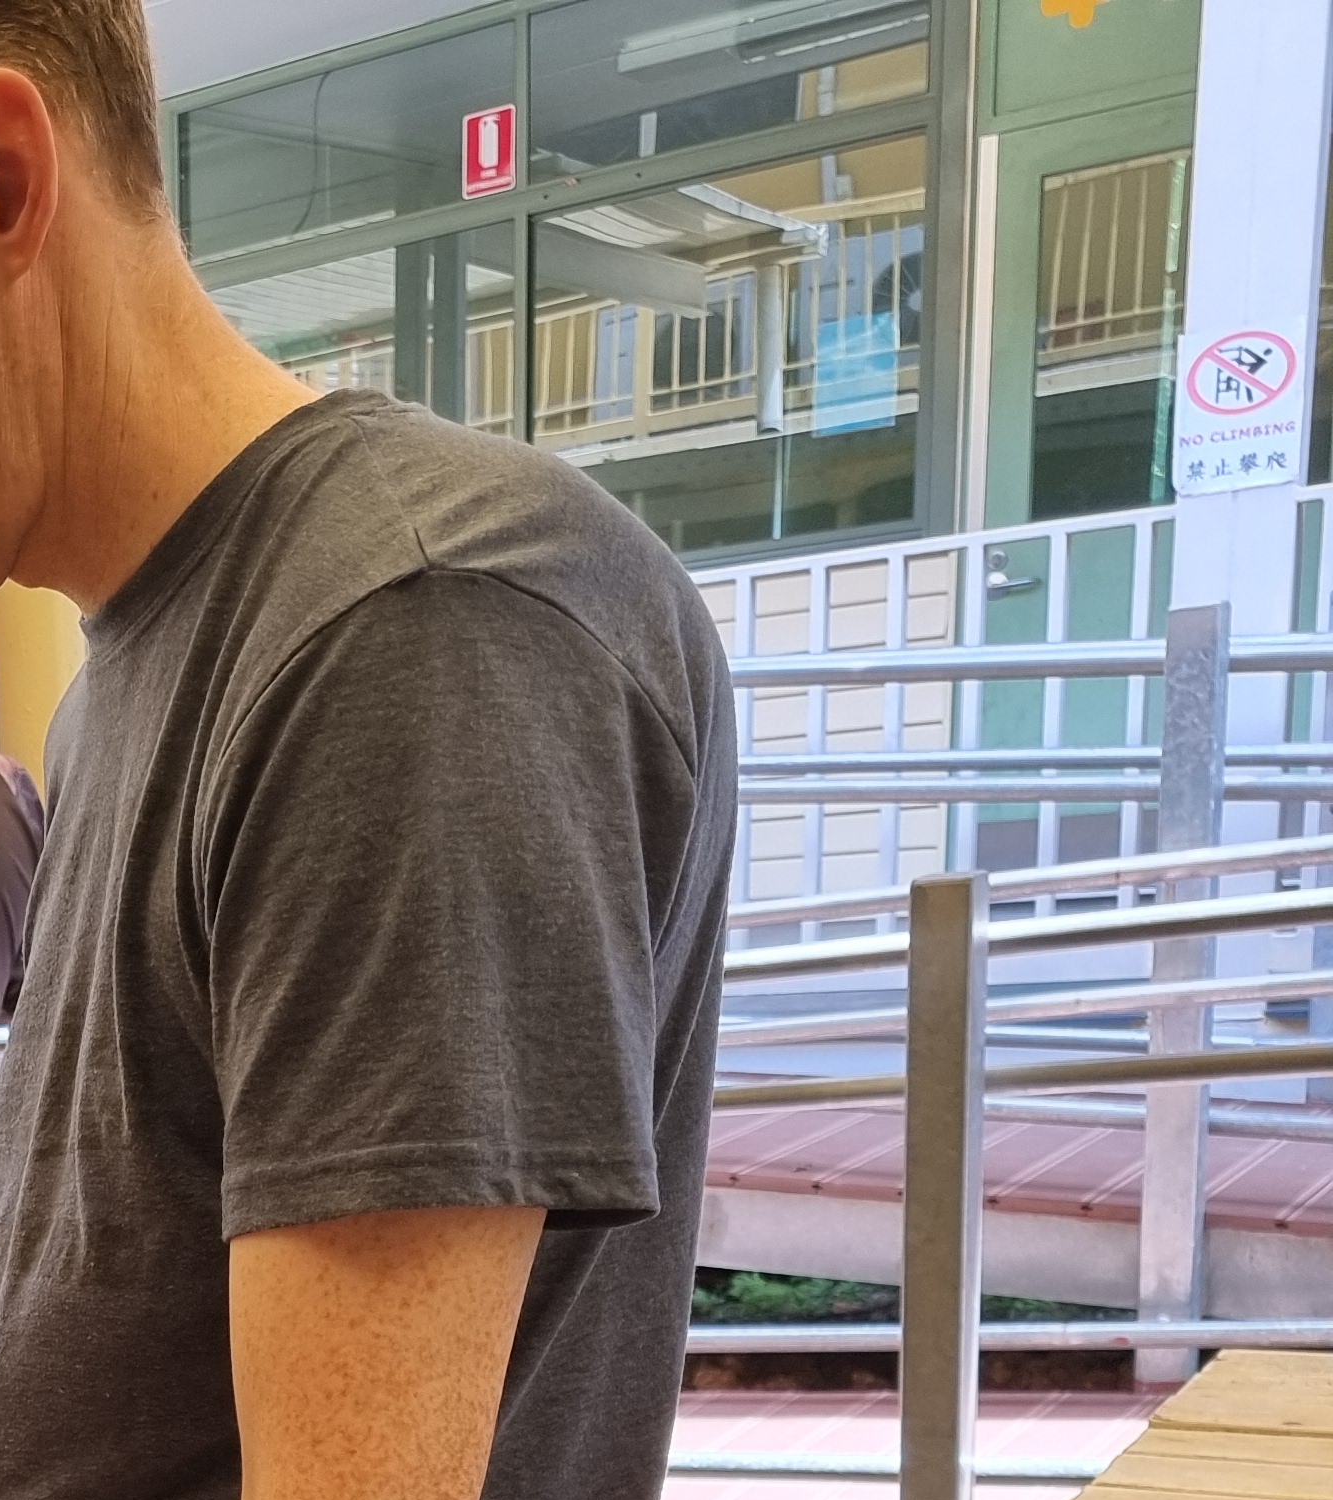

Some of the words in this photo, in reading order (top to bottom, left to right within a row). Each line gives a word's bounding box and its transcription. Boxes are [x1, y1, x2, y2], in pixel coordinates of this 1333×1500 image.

[1178, 434, 1204, 448] NO
[1209, 421, 1297, 443] CLIMBING
[1186, 450, 1288, 483] 禁止攀爬
